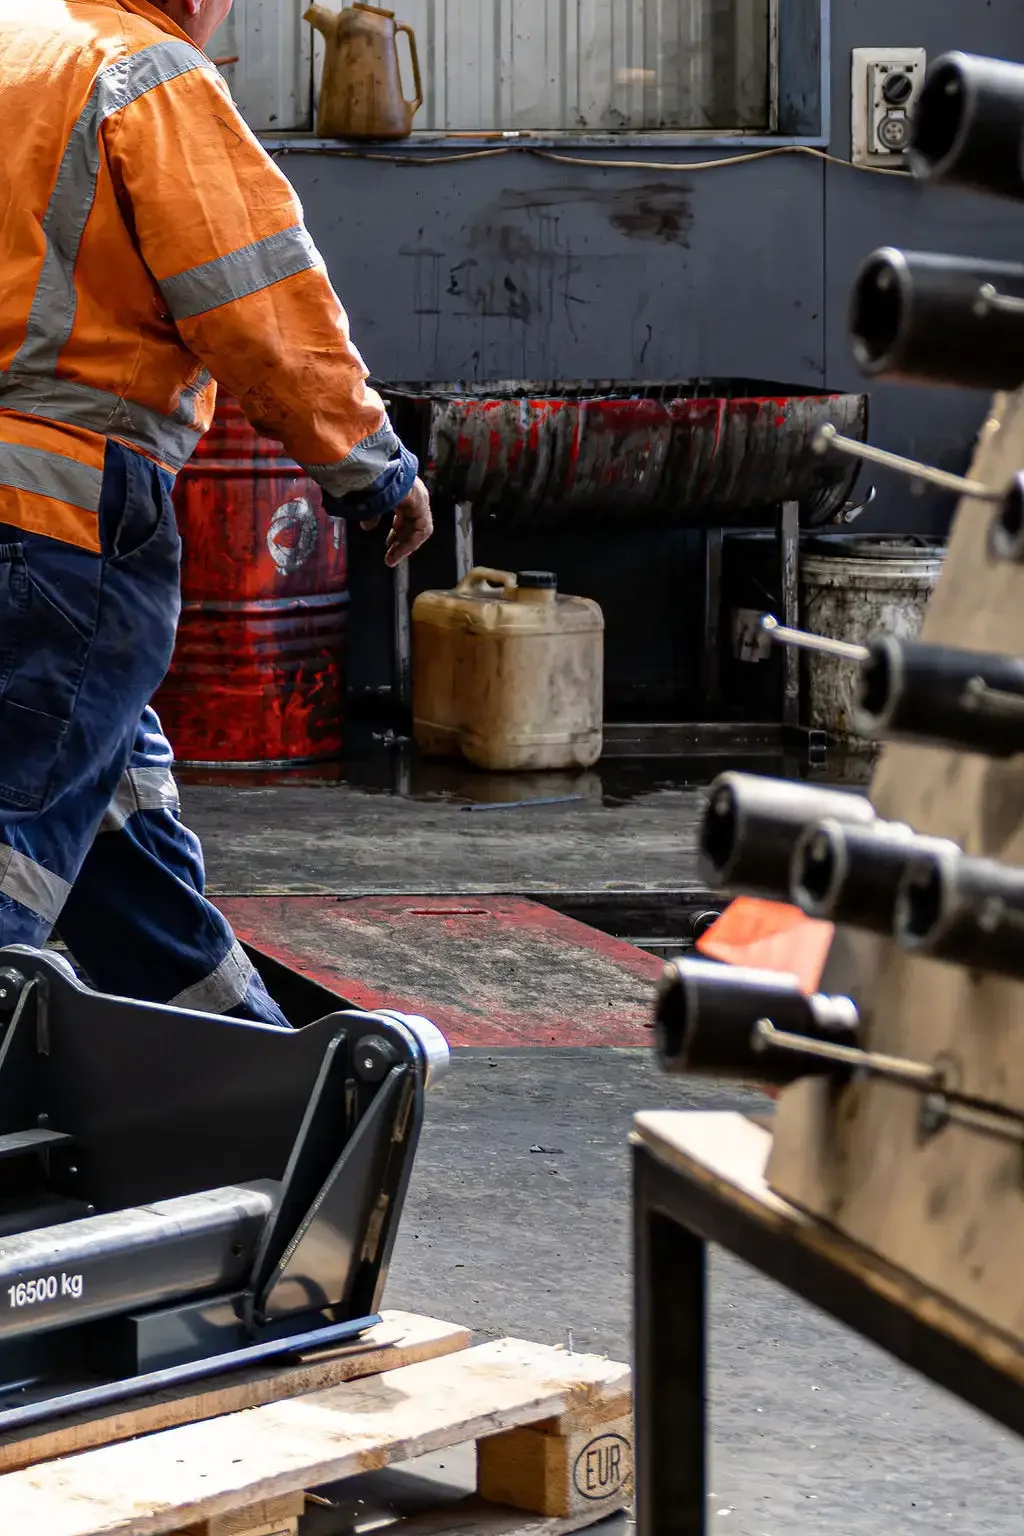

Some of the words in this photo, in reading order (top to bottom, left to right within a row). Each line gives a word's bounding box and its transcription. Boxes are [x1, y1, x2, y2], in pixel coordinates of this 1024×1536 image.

[7, 1274, 59, 1309] 16500
[60, 1272, 84, 1298] kg
[586, 1443, 622, 1491] EUR
